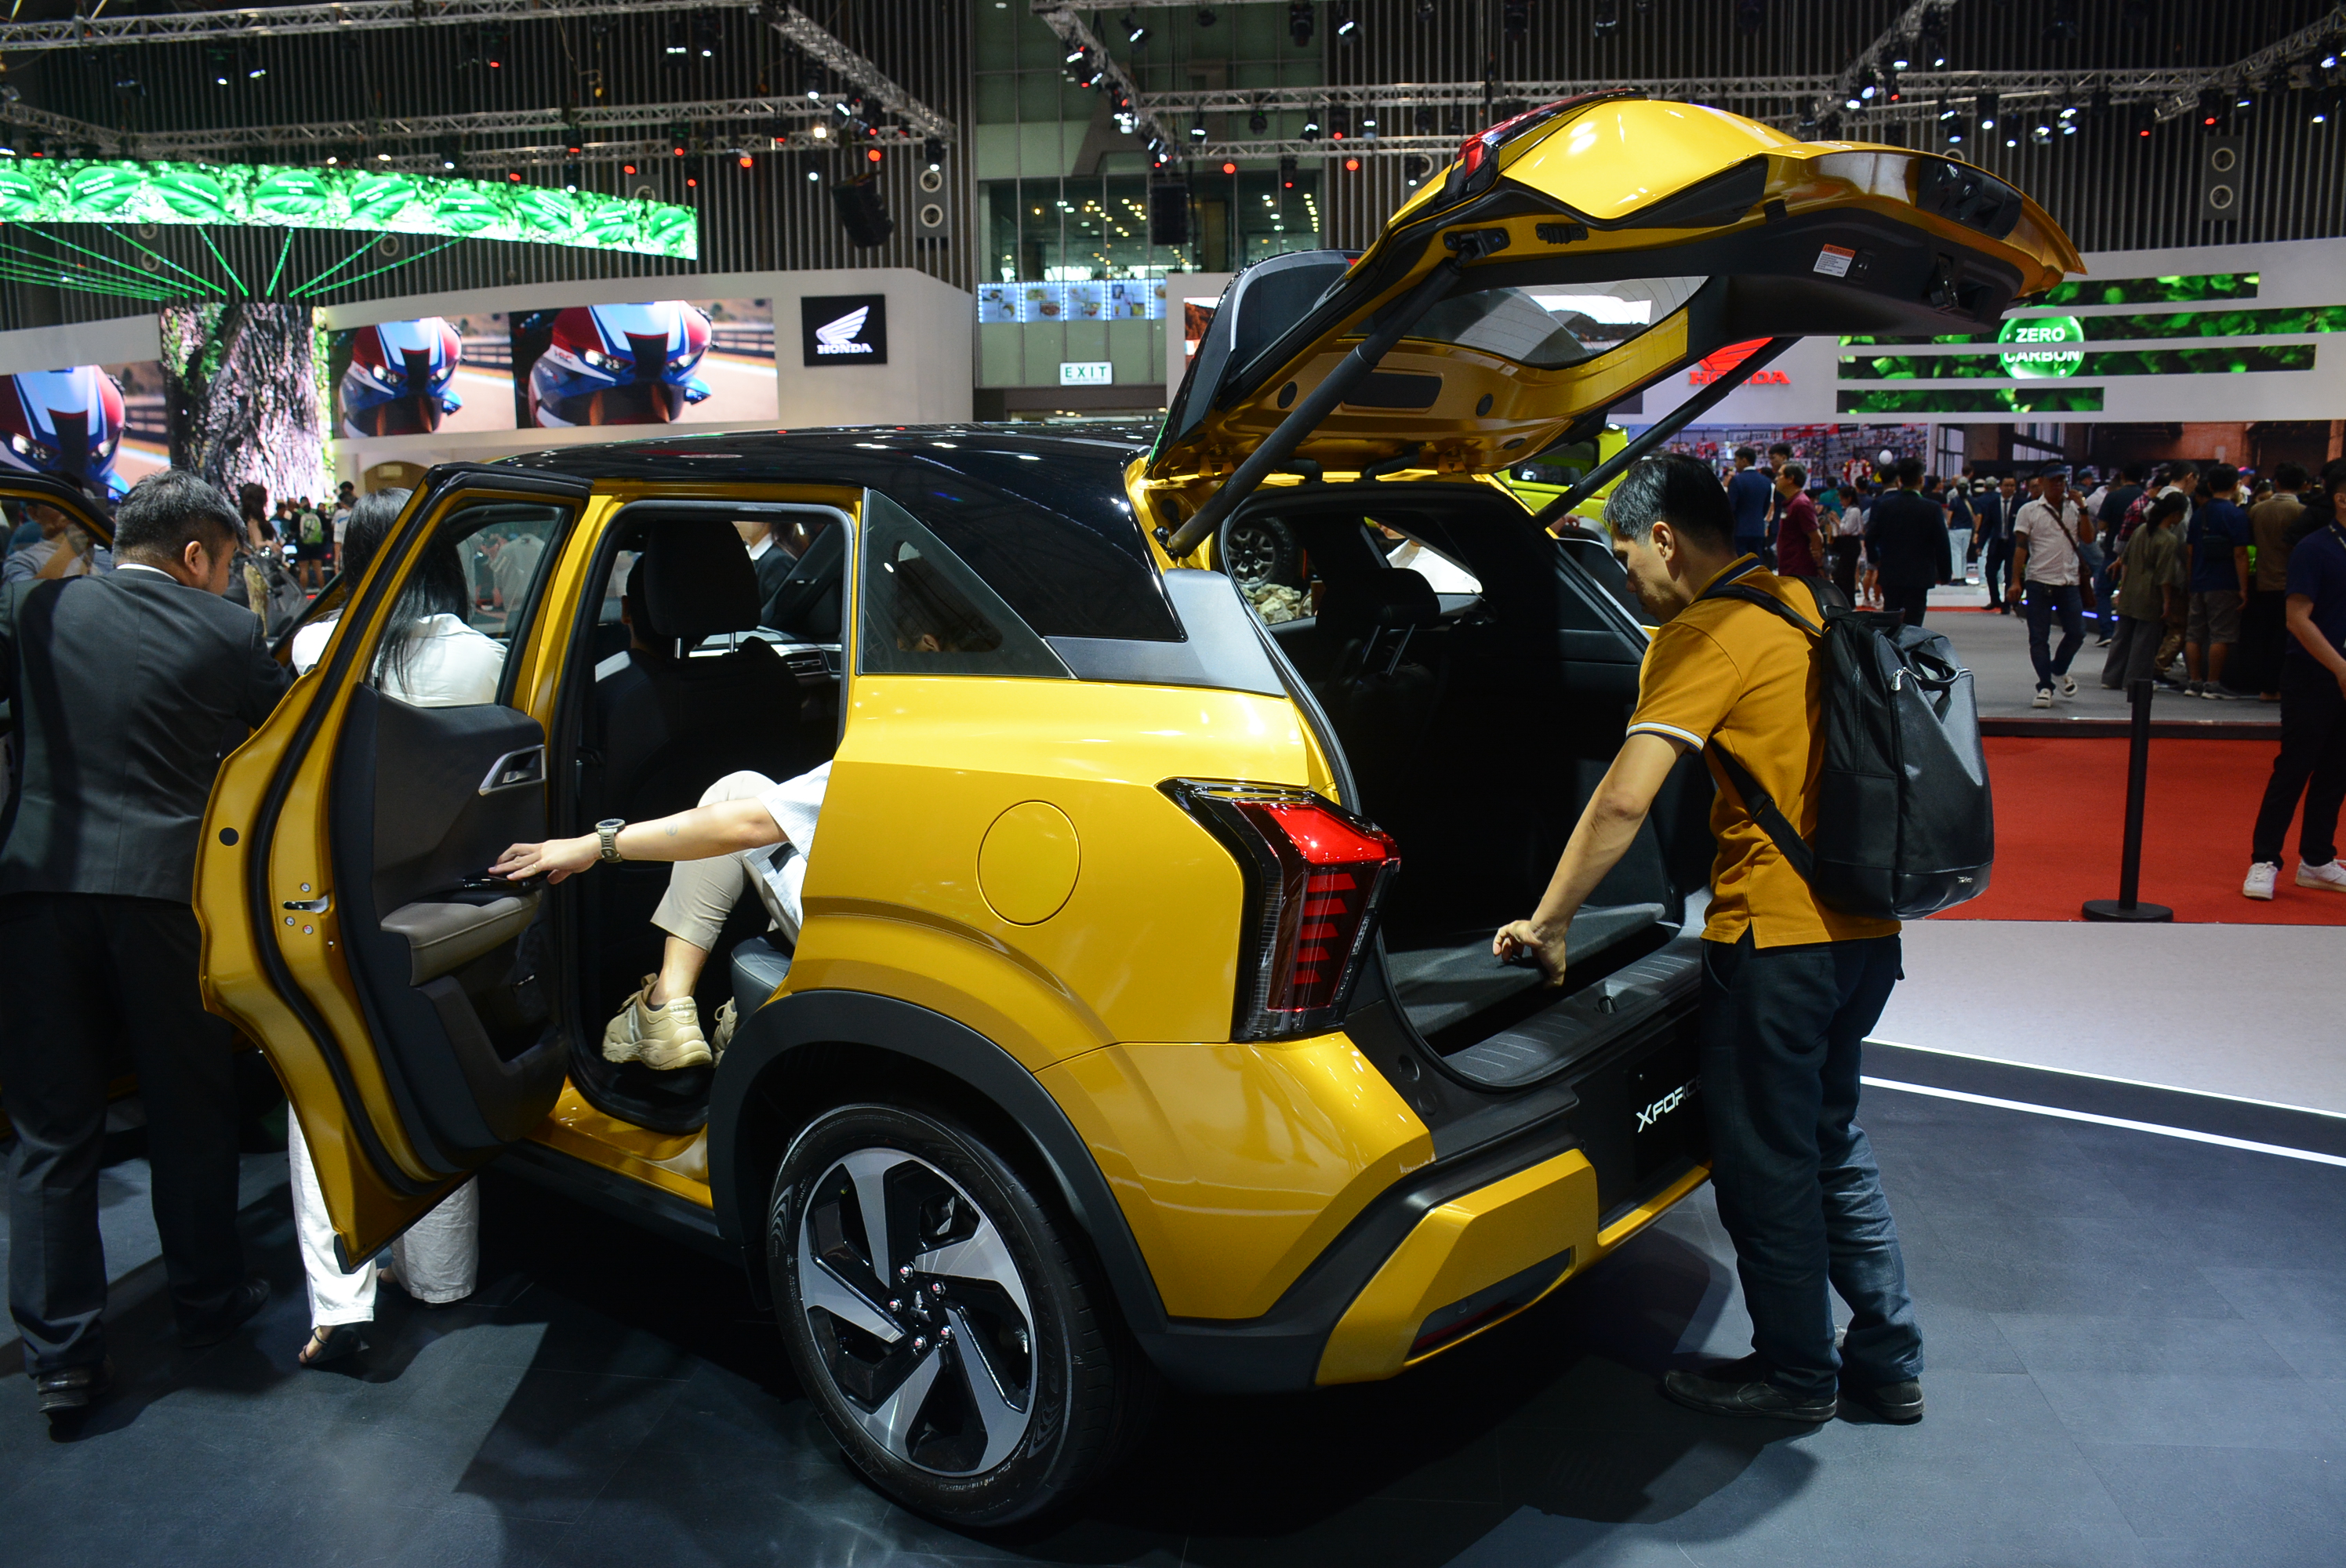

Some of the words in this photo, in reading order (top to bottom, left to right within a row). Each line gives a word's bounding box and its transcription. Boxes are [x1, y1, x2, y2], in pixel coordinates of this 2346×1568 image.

[2015, 328, 2066, 343] ZERO
[817, 343, 873, 354] HONDA
[1065, 366, 1106, 377] EXIT
[1690, 370, 1791, 384] HODA
